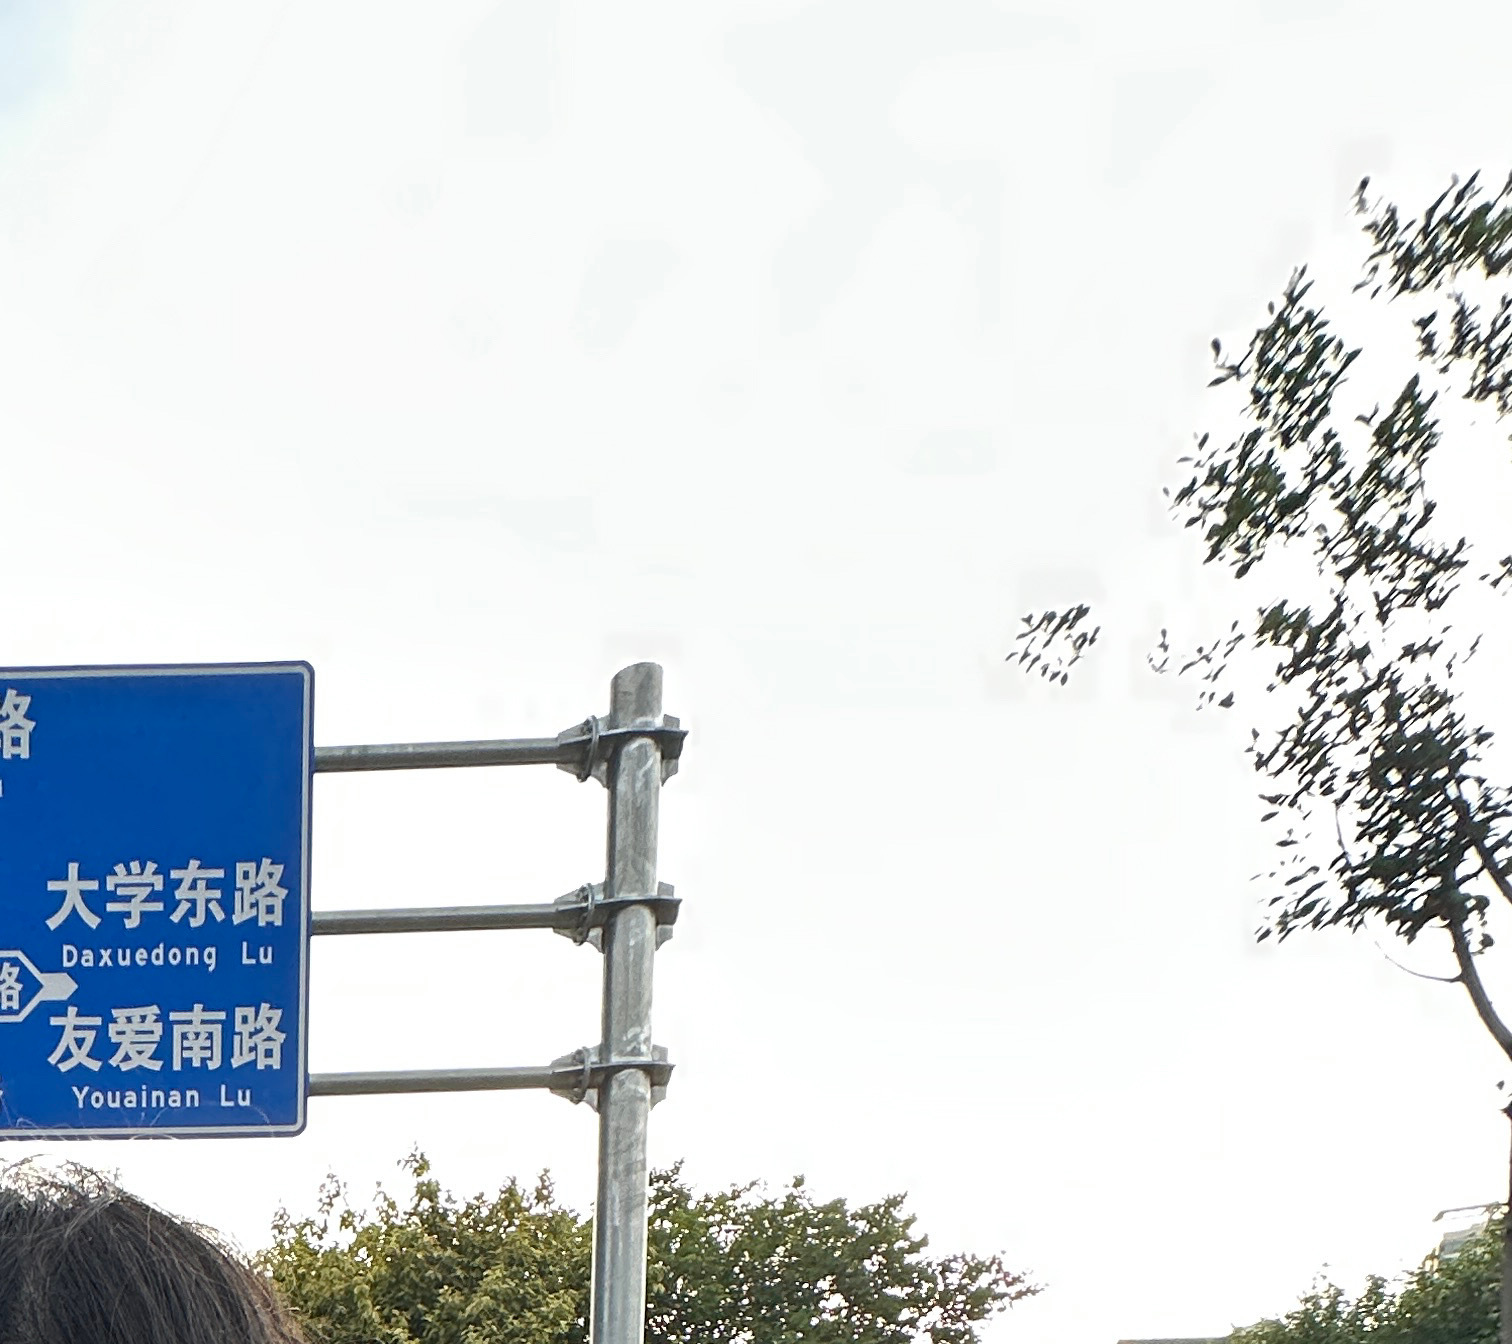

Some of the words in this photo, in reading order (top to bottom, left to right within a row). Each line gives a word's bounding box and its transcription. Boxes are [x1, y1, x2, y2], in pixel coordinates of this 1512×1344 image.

[46, 858, 288, 930] 大学东路
[62, 943, 216, 972] Daxuedong
[242, 941, 272, 964] Lu
[48, 1003, 285, 1072] 友爱南路
[72, 1085, 199, 1109] Youainan
[221, 1085, 251, 1107] Lu
